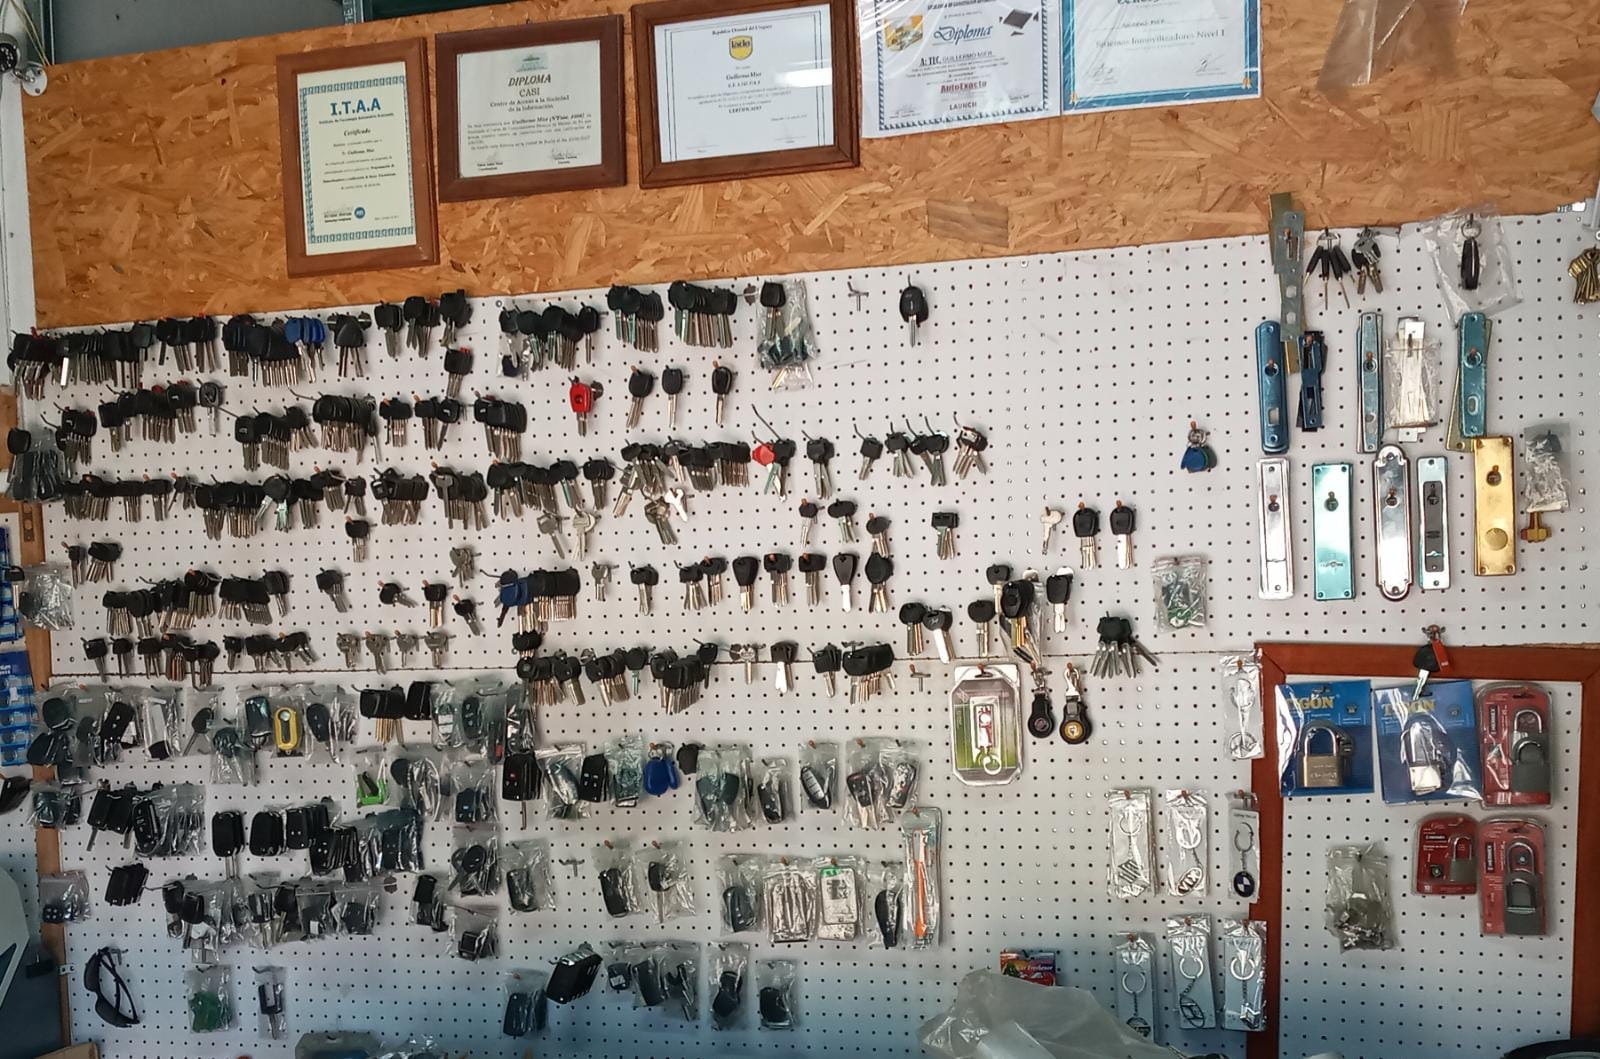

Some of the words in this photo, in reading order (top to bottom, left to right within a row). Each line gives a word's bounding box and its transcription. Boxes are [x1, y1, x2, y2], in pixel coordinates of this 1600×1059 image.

[933, 24, 993, 45] Diploma
[508, 73, 552, 87] DIPLOMA
[519, 87, 540, 97] CASI
[330, 97, 381, 116] I.T.A.A
[949, 101, 977, 111] LAUNCH
